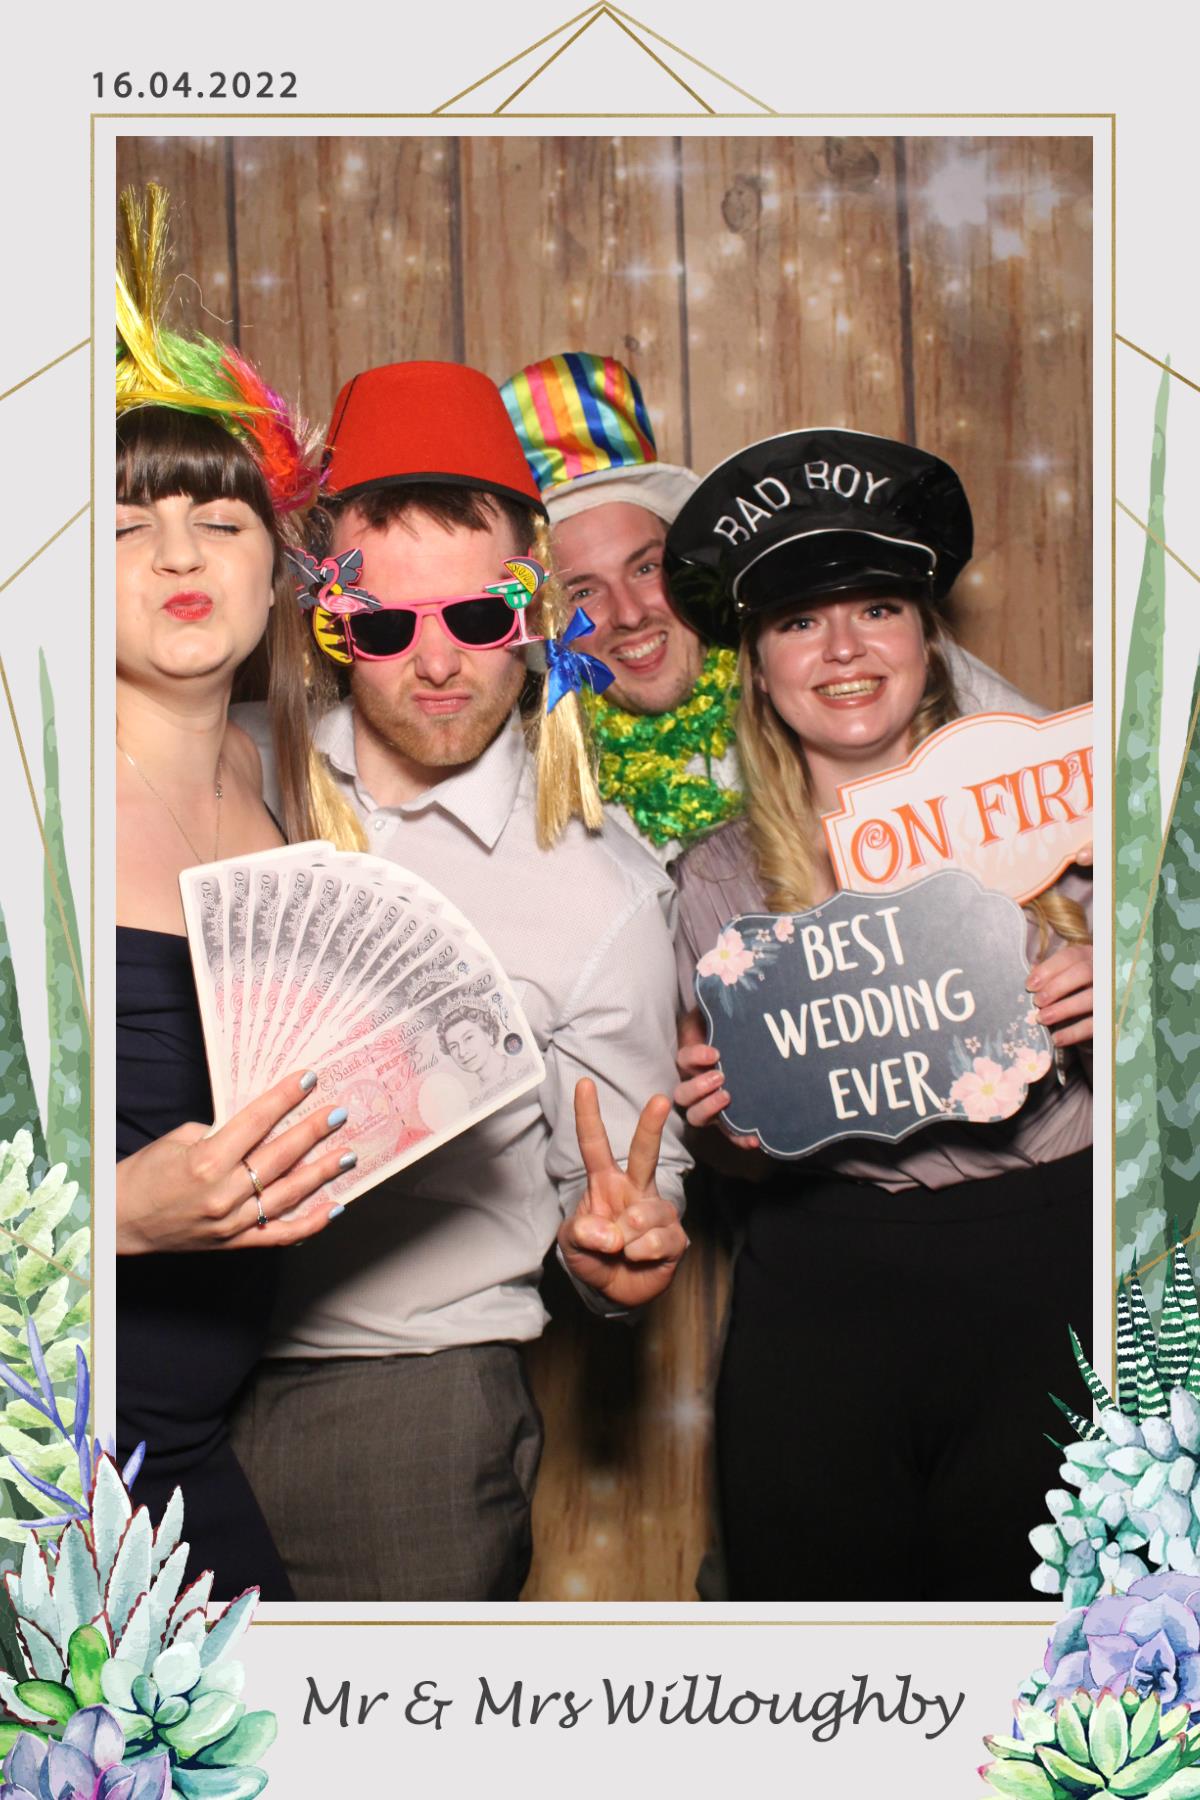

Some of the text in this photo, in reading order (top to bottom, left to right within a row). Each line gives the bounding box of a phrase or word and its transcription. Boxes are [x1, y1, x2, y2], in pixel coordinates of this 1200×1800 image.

[713, 460, 891, 546] BAD BOY
[850, 795, 953, 885] ON
[800, 906, 906, 981] BEST
[763, 968, 976, 1059] WEDDING
[828, 1051, 945, 1120] EVER
